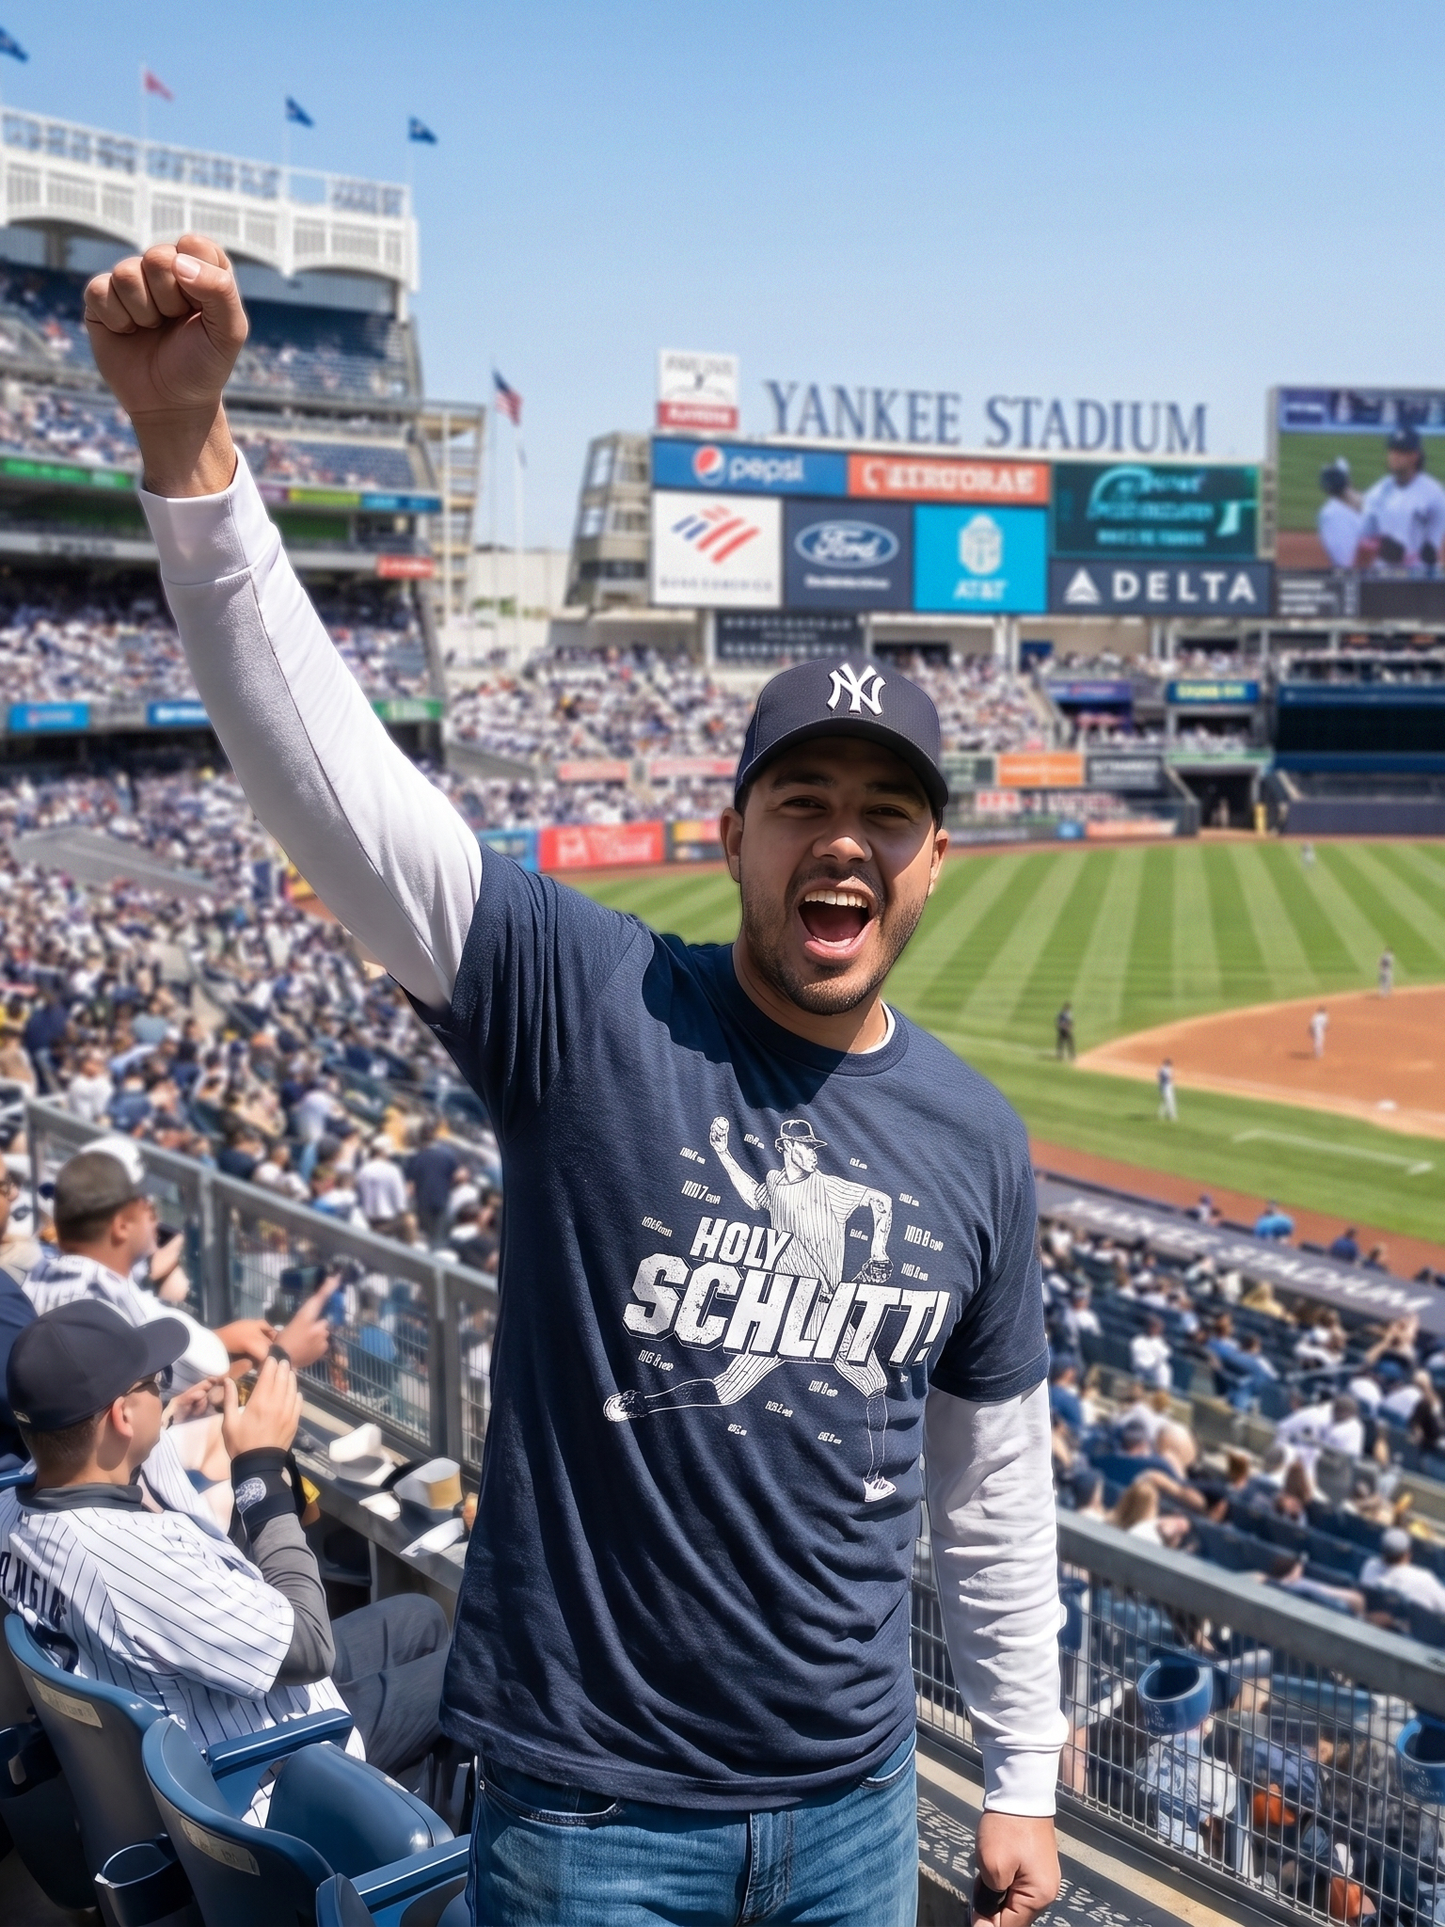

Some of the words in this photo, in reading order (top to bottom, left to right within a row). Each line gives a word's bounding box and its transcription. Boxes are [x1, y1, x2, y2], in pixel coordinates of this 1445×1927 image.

[764, 378, 962, 448] YANKEE
[984, 394, 1209, 456] STADIUM
[729, 454, 804, 484] pepsi
[813, 524, 883, 560] Ford
[1112, 570, 1258, 603] DELTA
[827, 662, 887, 716] NY
[690, 1216, 794, 1271] HOLY
